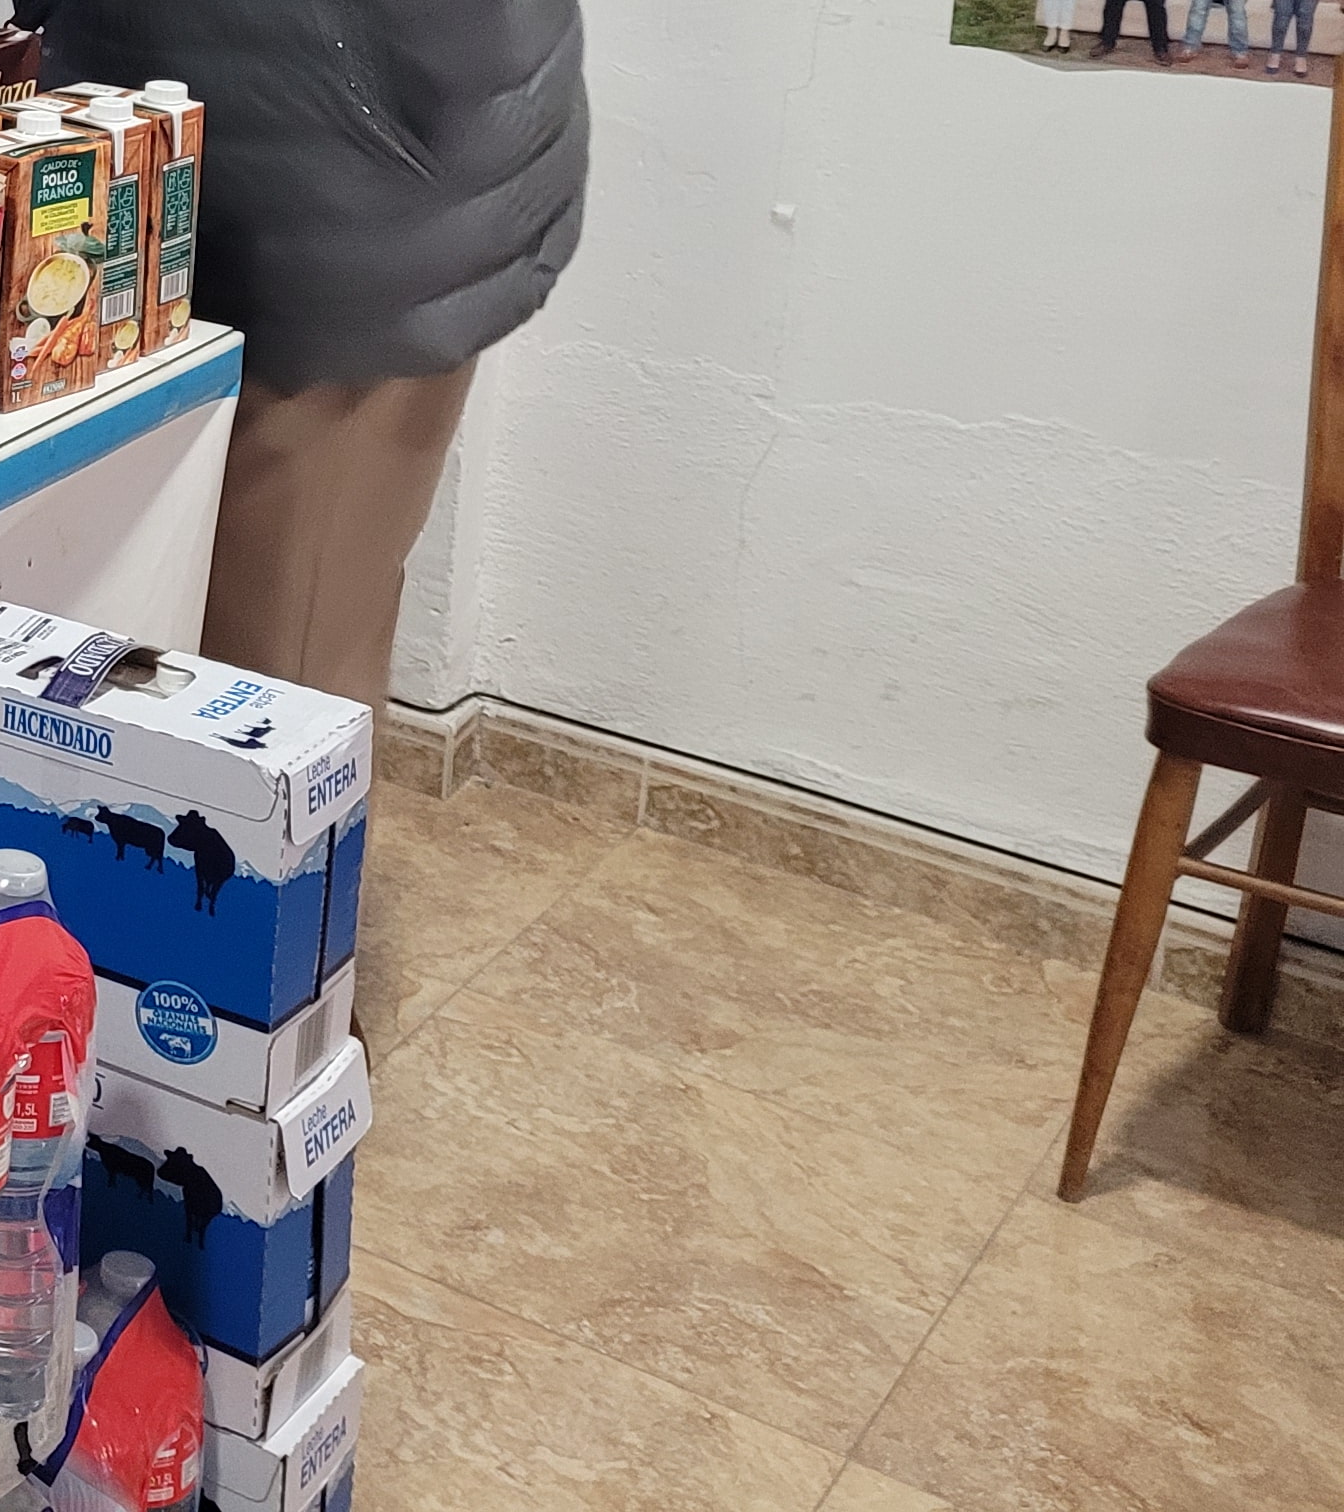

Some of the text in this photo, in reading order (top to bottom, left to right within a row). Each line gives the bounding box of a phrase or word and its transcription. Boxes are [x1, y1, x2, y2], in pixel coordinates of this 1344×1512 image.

[37, 182, 84, 204] FRANGO
[42, 169, 78, 188] POLLO
[191, 680, 264, 721] ENTERA
[2, 702, 113, 759] HACENDADO
[306, 755, 331, 783] Leche
[308, 757, 357, 816] ENTERA
[152, 990, 199, 1013] 100%
[304, 1099, 357, 1168] ENTERA
[300, 1415, 348, 1490] ENTERA
